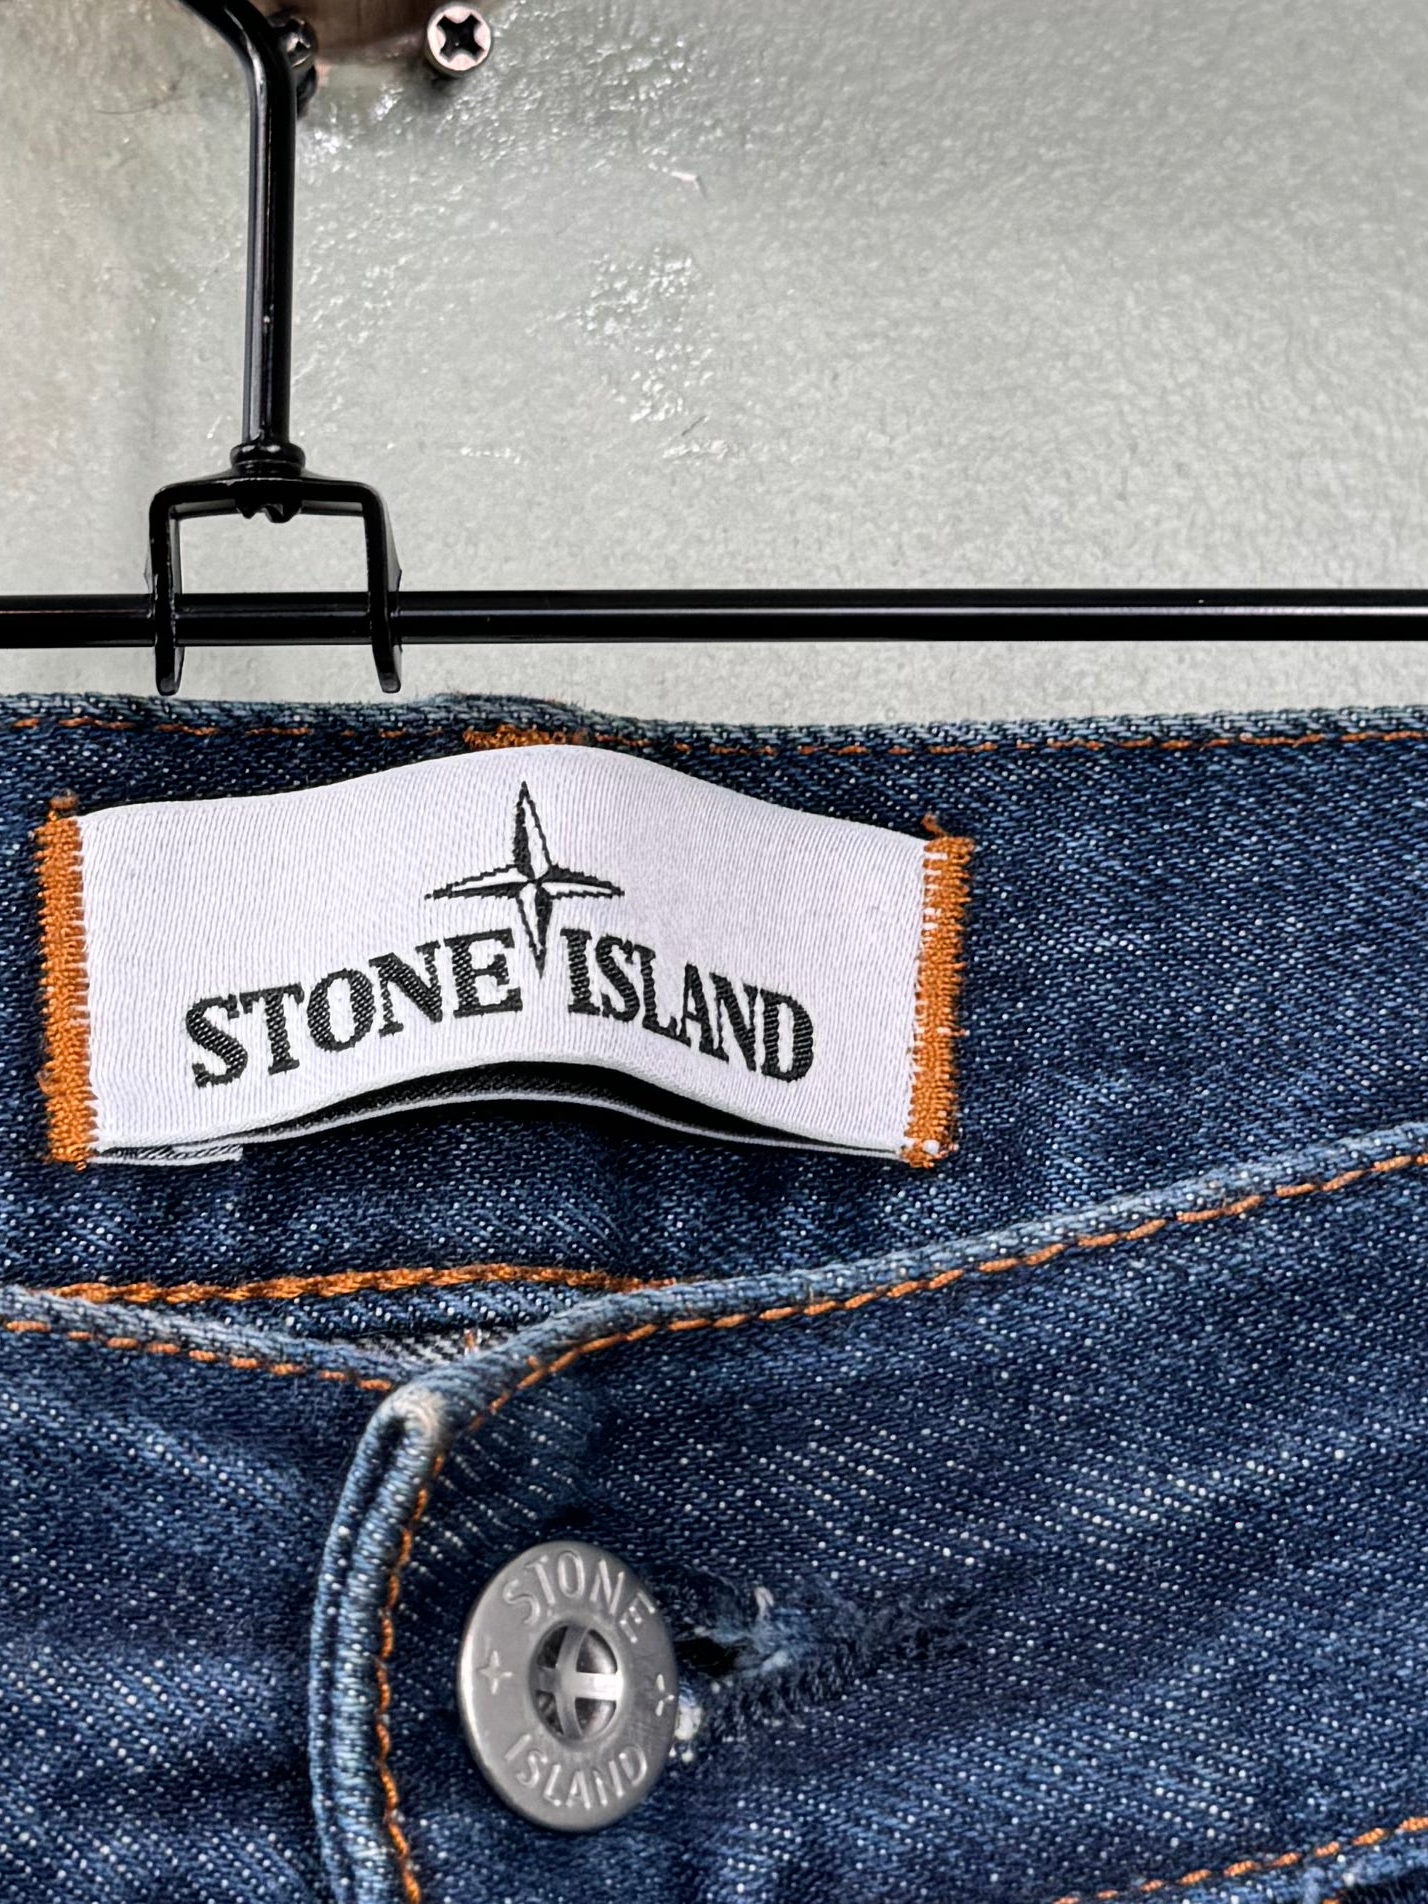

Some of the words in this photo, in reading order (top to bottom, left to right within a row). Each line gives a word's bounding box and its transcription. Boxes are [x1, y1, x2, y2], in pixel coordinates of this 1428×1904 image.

[184, 928, 522, 1089] STONE
[560, 928, 815, 1083] ISLAND
[502, 1549, 657, 1644] STONE
[504, 1733, 649, 1810] ISLAND
